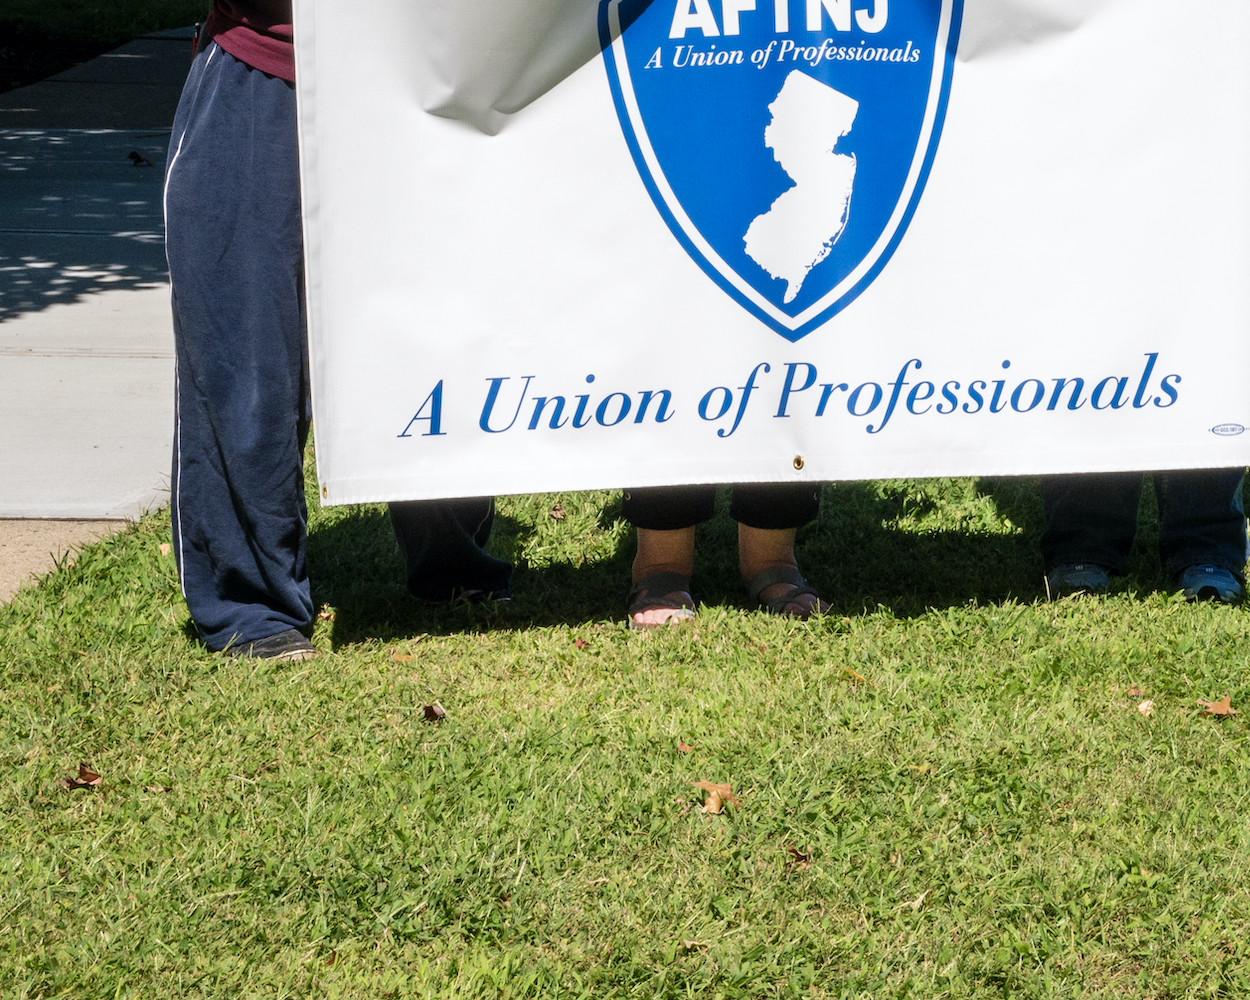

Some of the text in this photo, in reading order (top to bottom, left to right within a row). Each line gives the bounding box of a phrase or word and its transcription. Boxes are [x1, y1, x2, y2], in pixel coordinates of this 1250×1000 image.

[644, 36, 921, 70] A Union of Professionals
[397, 352, 1182, 438] A Union of Professionals
